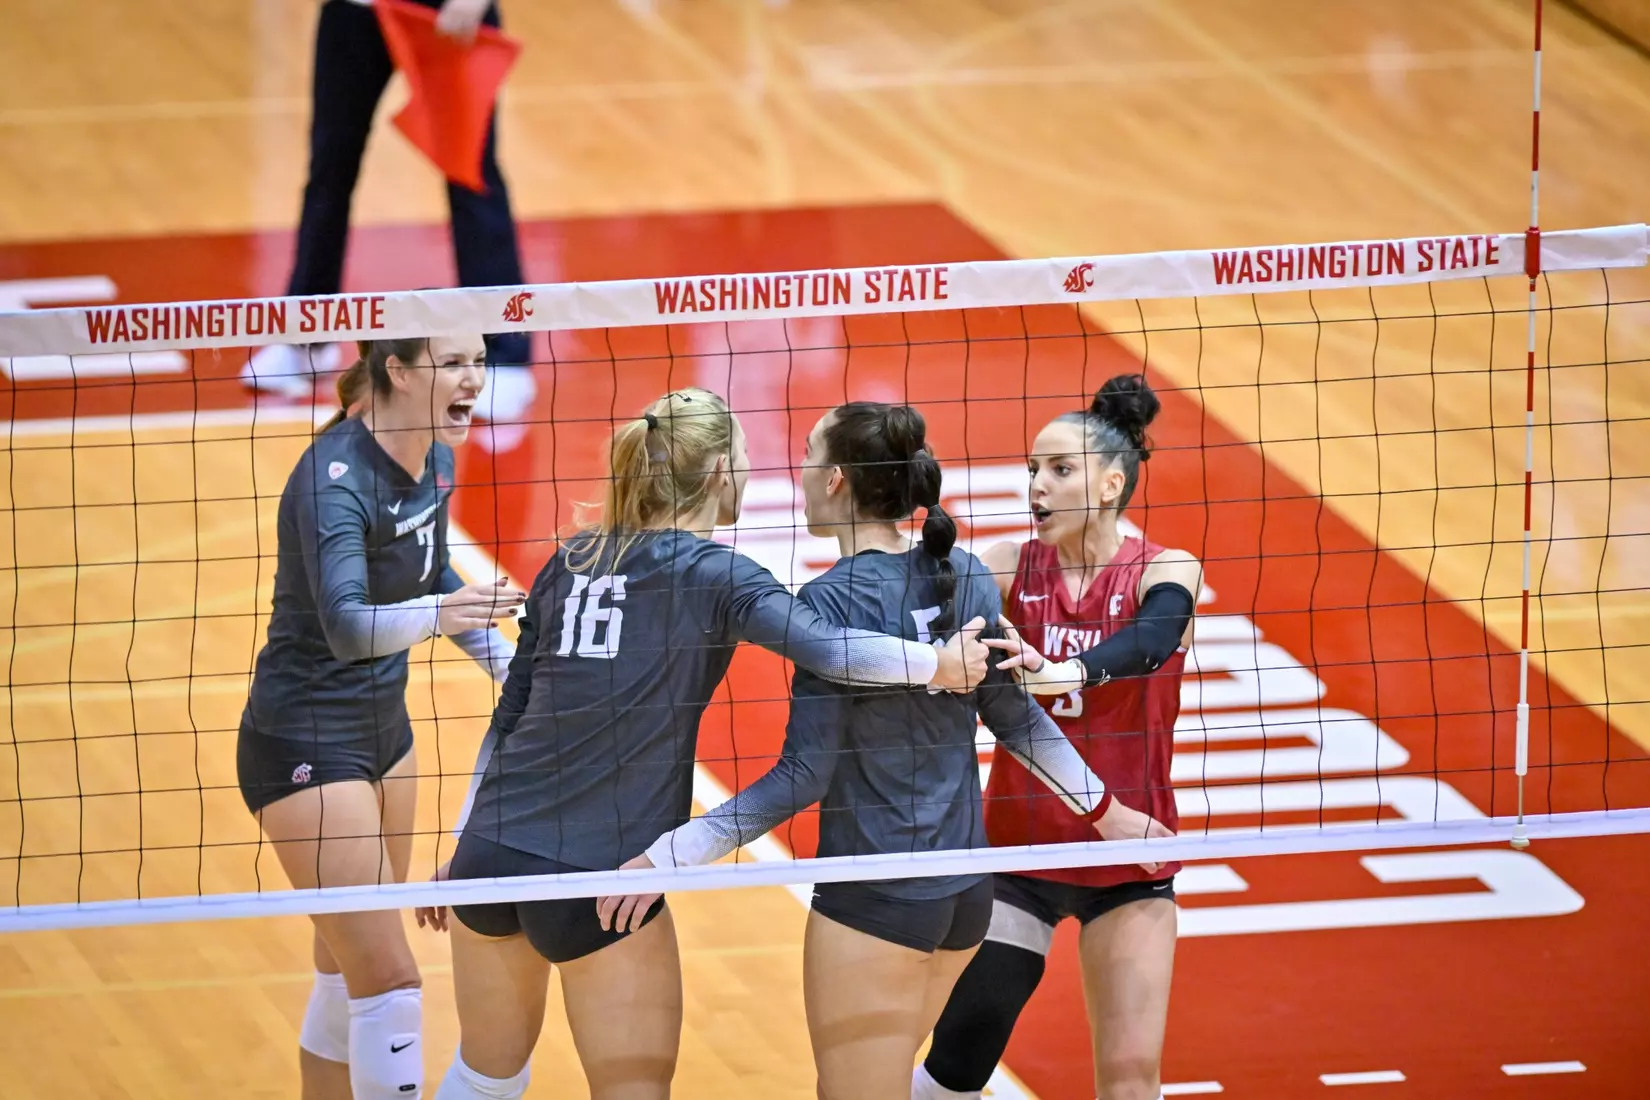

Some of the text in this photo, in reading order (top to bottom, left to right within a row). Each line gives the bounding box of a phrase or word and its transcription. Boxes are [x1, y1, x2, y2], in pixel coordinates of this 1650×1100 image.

[1211, 235, 1500, 285] WASHINGTON STATE
[654, 267, 949, 315] WASHINGTON STATE
[85, 296, 385, 344] WASHINGTON STATE
[416, 520, 436, 582] 7
[556, 574, 627, 659] 16
